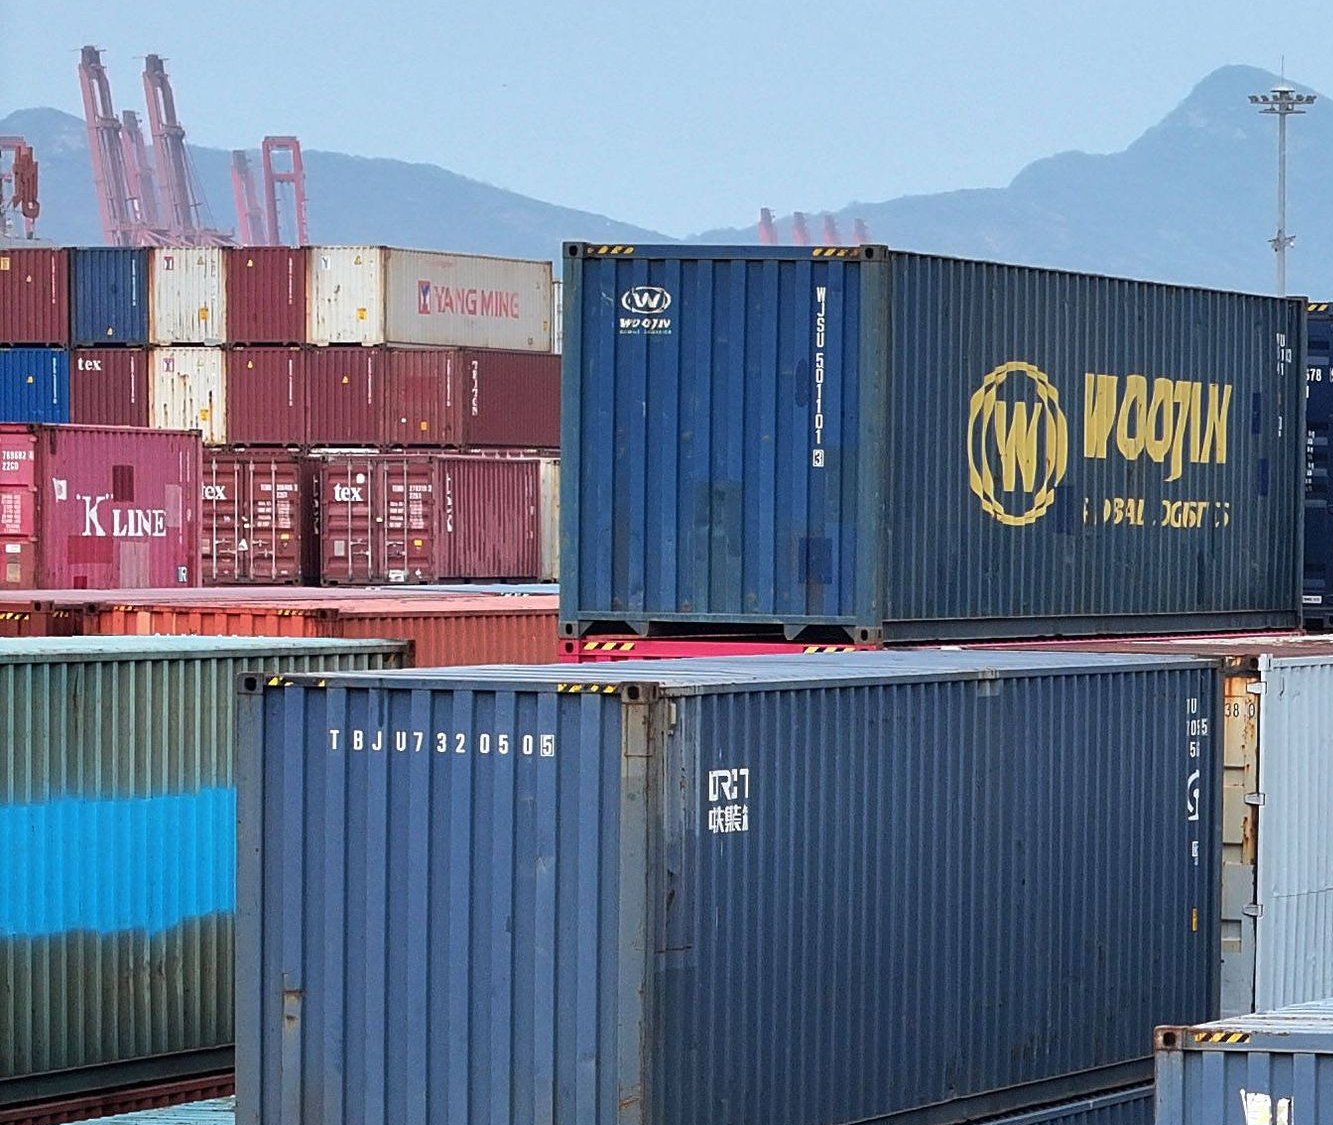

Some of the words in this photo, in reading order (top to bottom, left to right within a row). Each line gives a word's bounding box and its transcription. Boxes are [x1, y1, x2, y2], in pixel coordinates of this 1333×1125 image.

[434, 285, 478, 315] YANG
[481, 289, 520, 320] MING
[815, 287, 826, 348] WJSU
[78, 357, 102, 371] tex
[815, 353, 825, 444] 501101
[334, 483, 363, 501] tex
[112, 509, 167, 537] LINE
